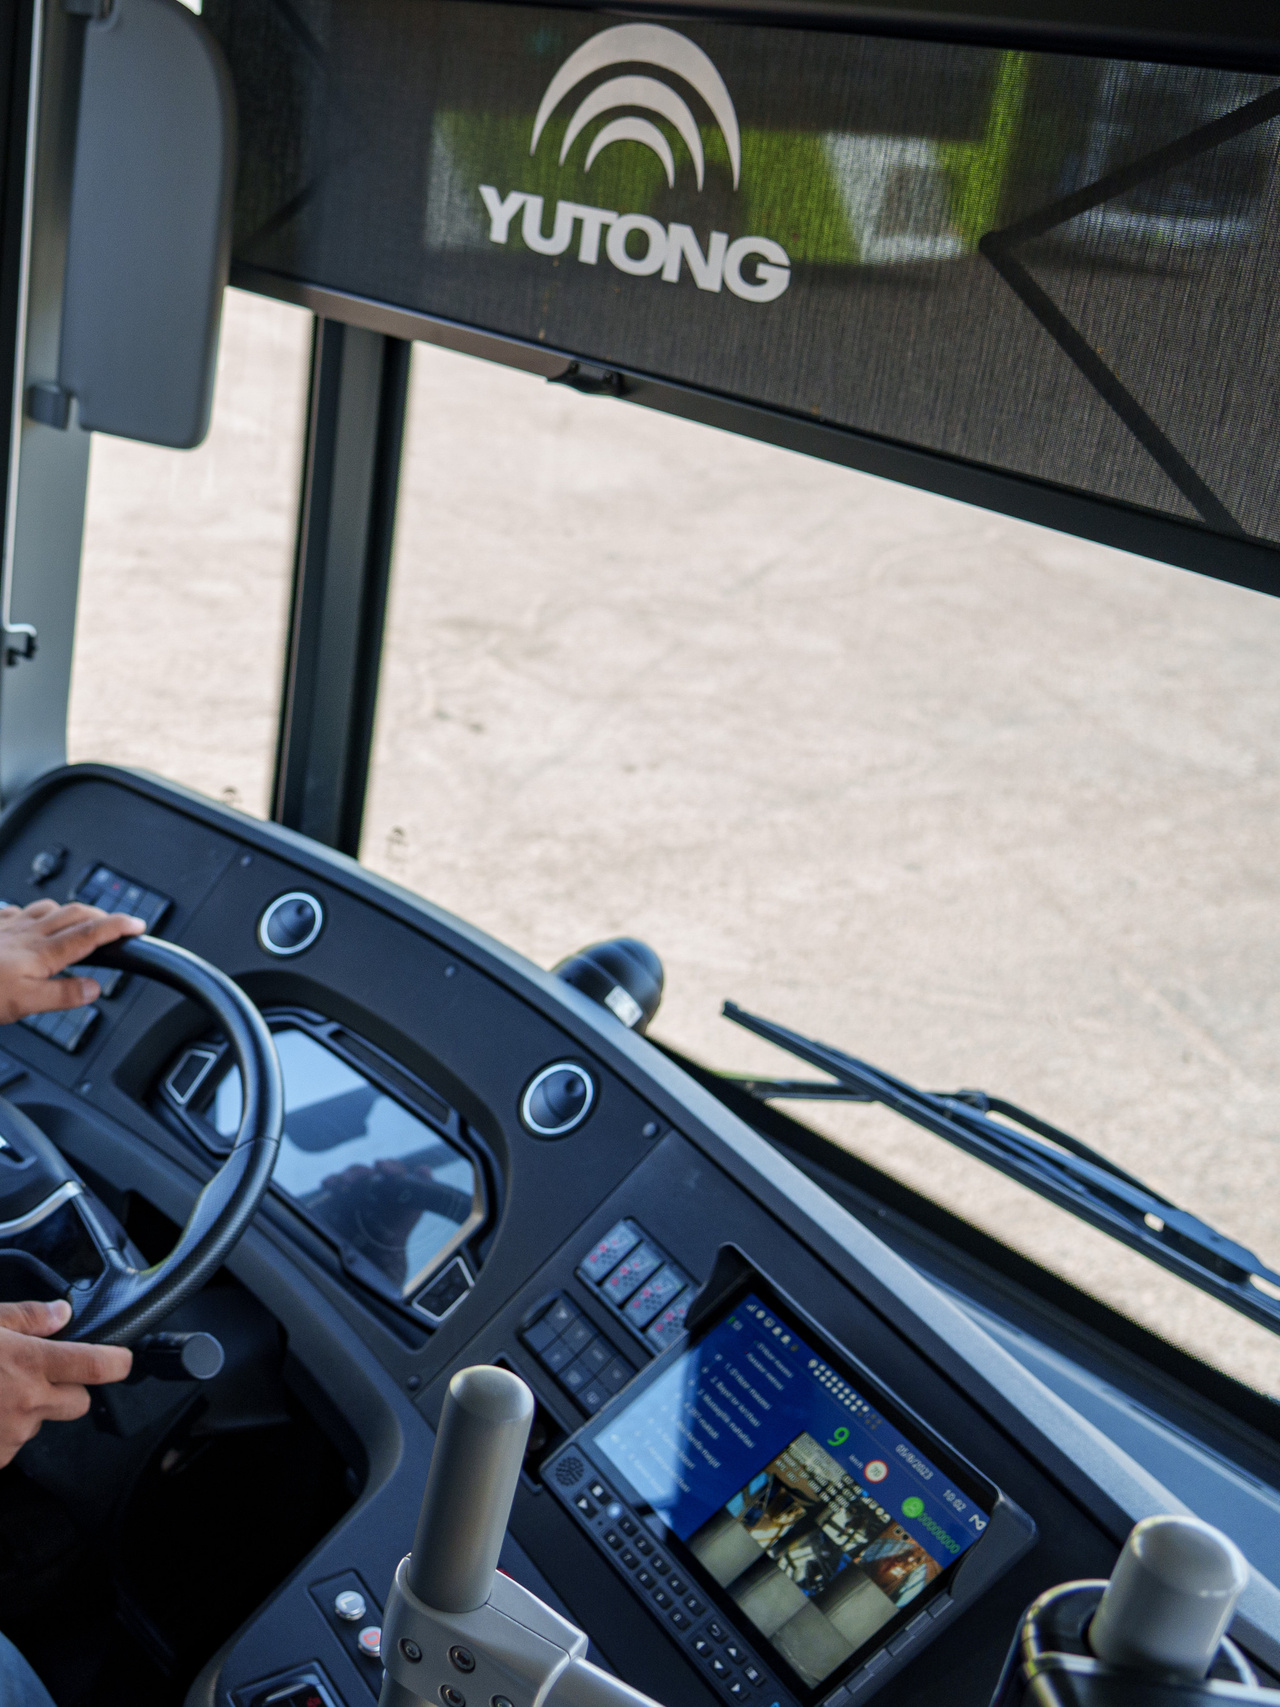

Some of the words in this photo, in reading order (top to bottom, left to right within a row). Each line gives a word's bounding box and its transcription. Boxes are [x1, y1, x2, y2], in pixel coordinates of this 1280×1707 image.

[478, 184, 791, 303] YUTONG
[827, 1427, 850, 1446] 9
[363, 1631, 380, 1645] D
